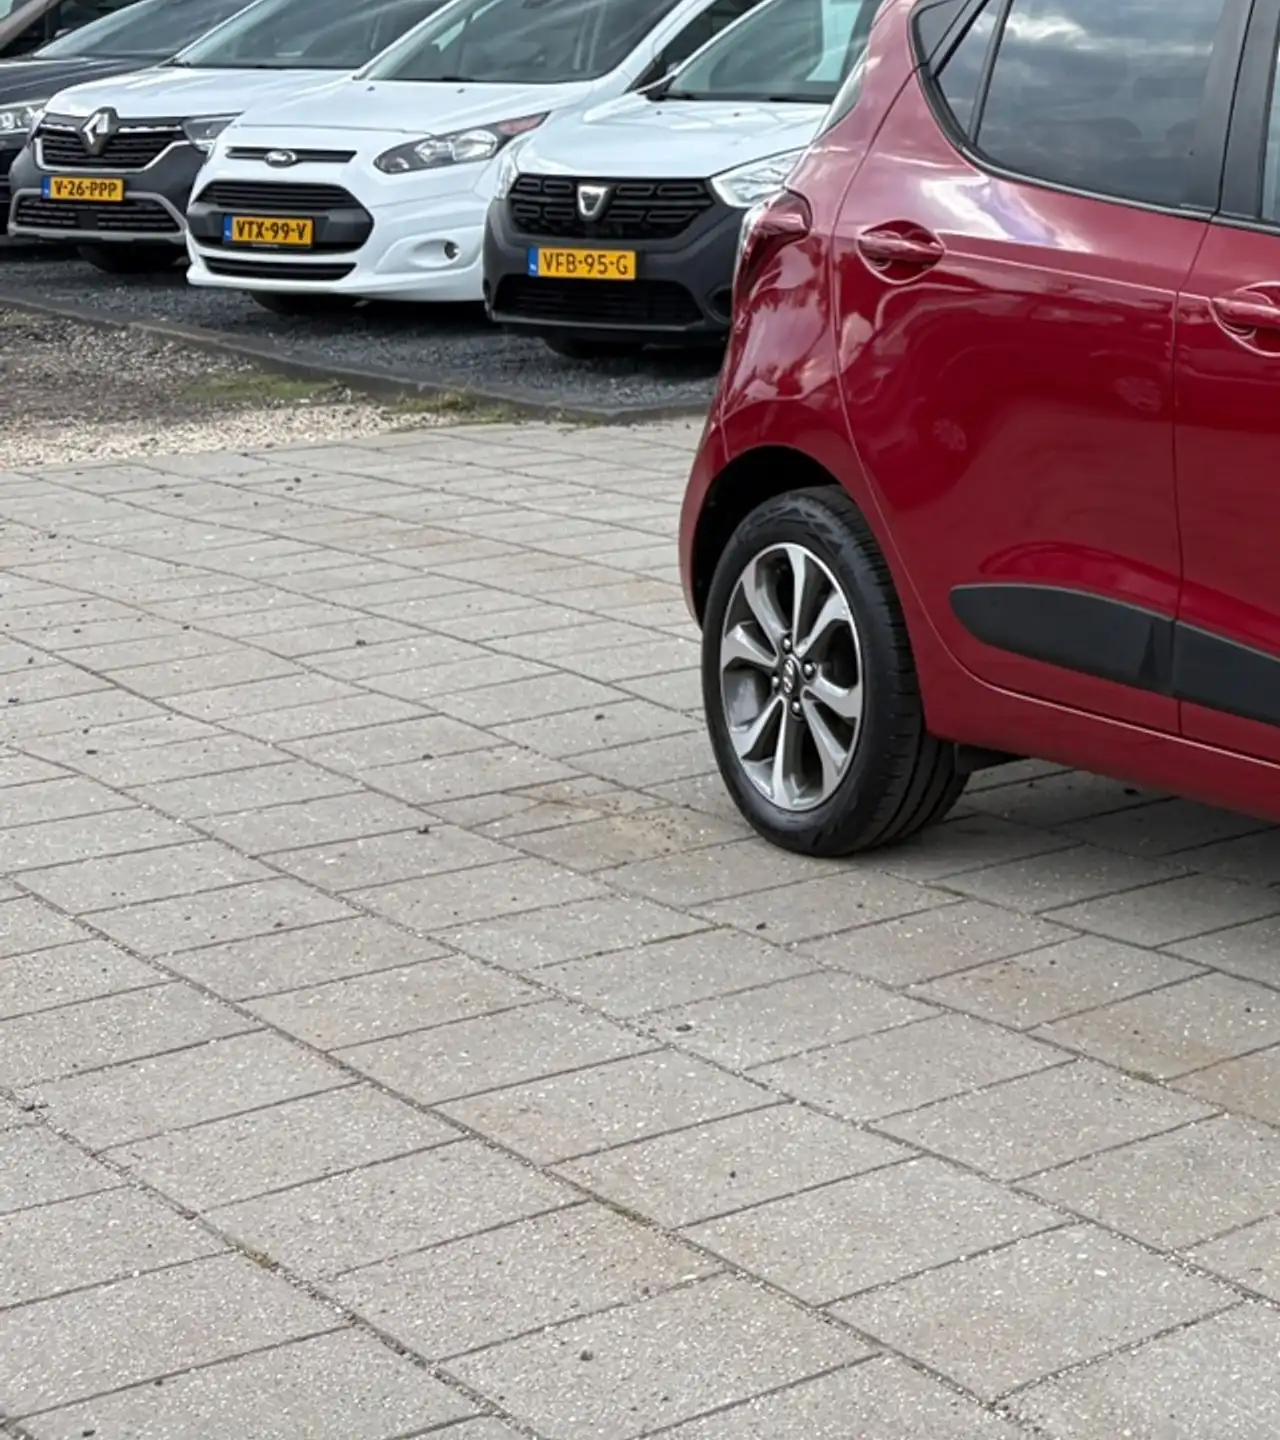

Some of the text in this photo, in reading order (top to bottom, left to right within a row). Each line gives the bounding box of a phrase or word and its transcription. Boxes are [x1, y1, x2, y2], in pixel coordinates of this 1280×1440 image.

[54, 180, 117, 198] V-26-PPP
[235, 220, 307, 241] VTX-99-V
[542, 252, 629, 276] VFB-95-G
